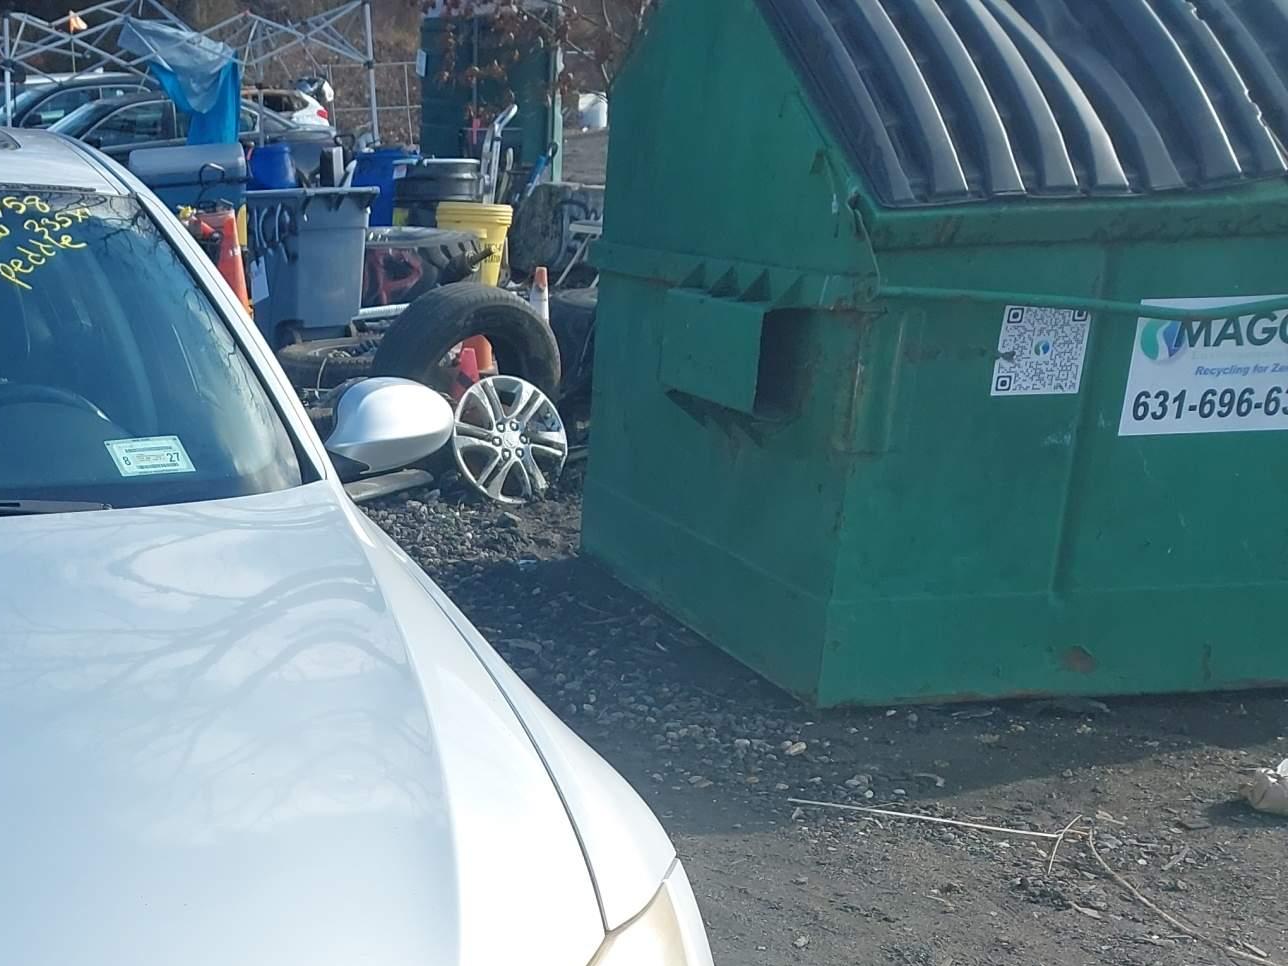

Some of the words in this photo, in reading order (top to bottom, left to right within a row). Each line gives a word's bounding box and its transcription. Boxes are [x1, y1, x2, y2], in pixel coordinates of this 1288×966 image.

[1195, 365, 1250, 378] Recycling
[1253, 364, 1269, 374] for
[122, 456, 132, 466] 8
[166, 452, 180, 463] 27
